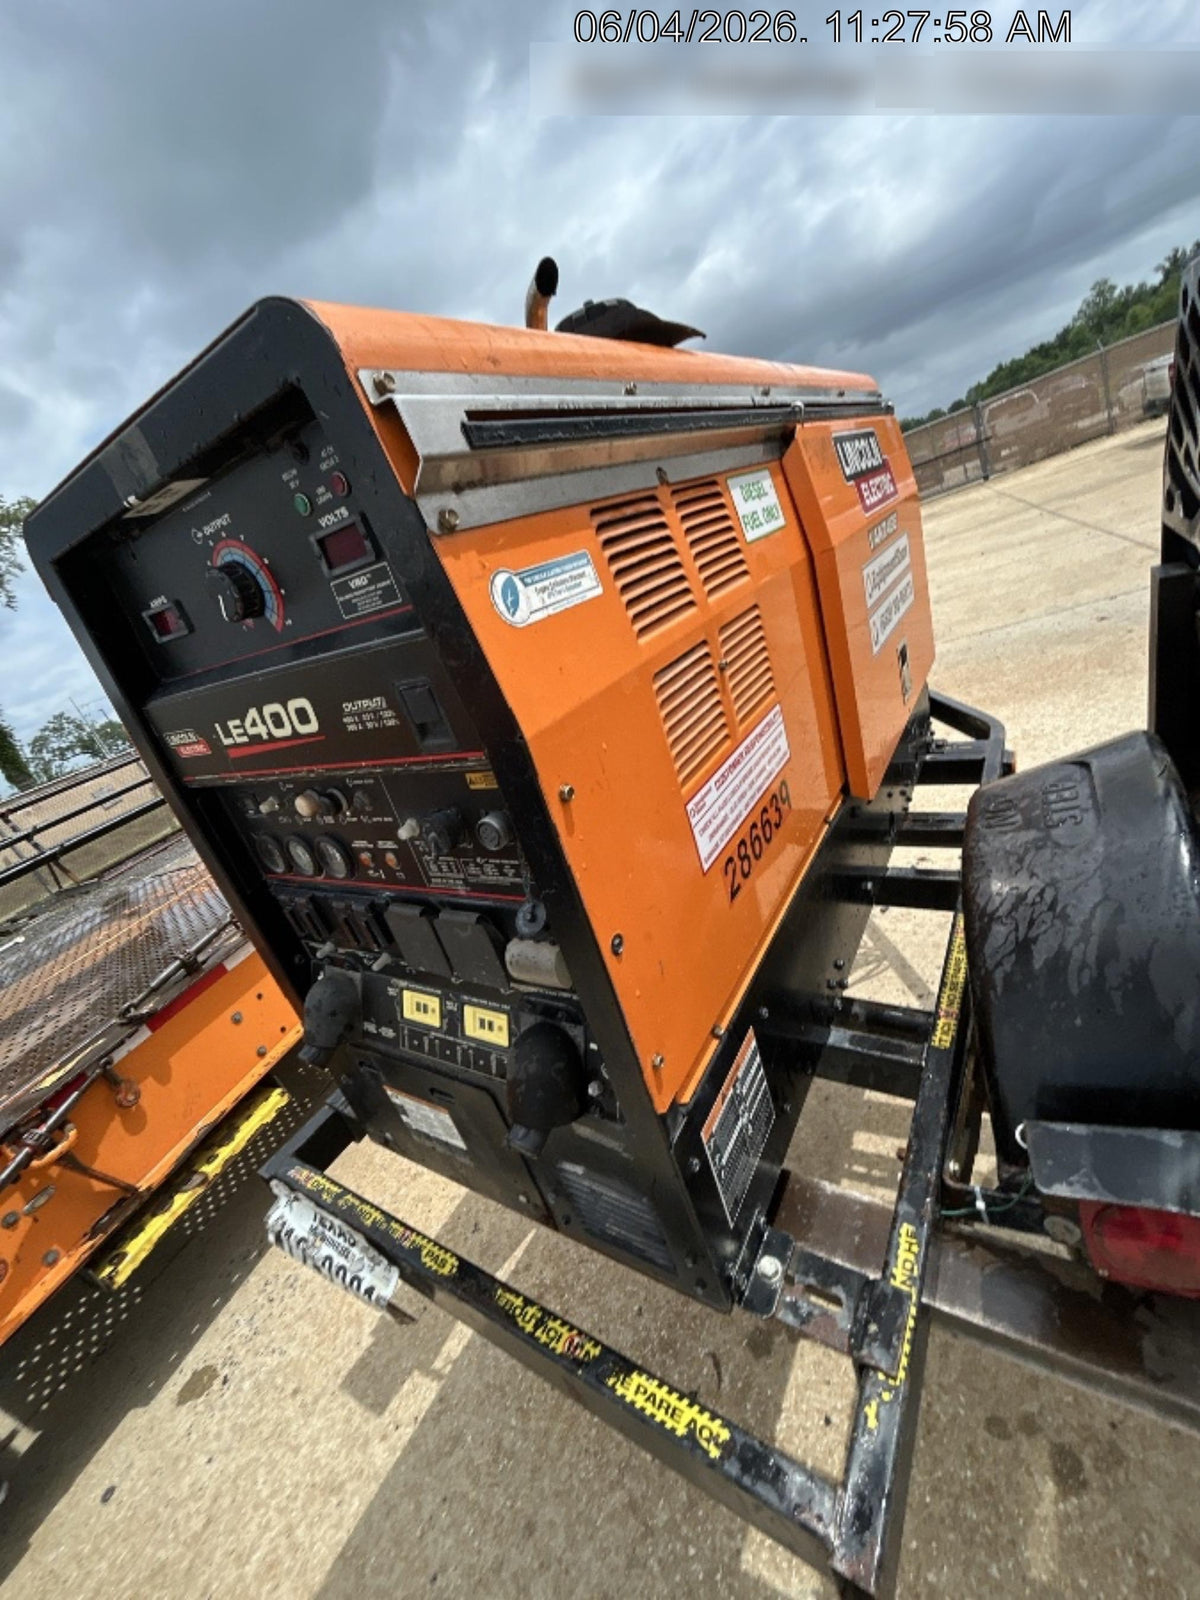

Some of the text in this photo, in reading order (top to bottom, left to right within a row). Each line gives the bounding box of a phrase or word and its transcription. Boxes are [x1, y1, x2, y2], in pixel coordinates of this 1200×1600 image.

[203, 513, 231, 536] OUTPUT
[318, 506, 349, 527] VOLTS
[215, 697, 320, 746] LE400
[724, 779, 792, 903] 286639
[634, 1383, 684, 1425] PARE
